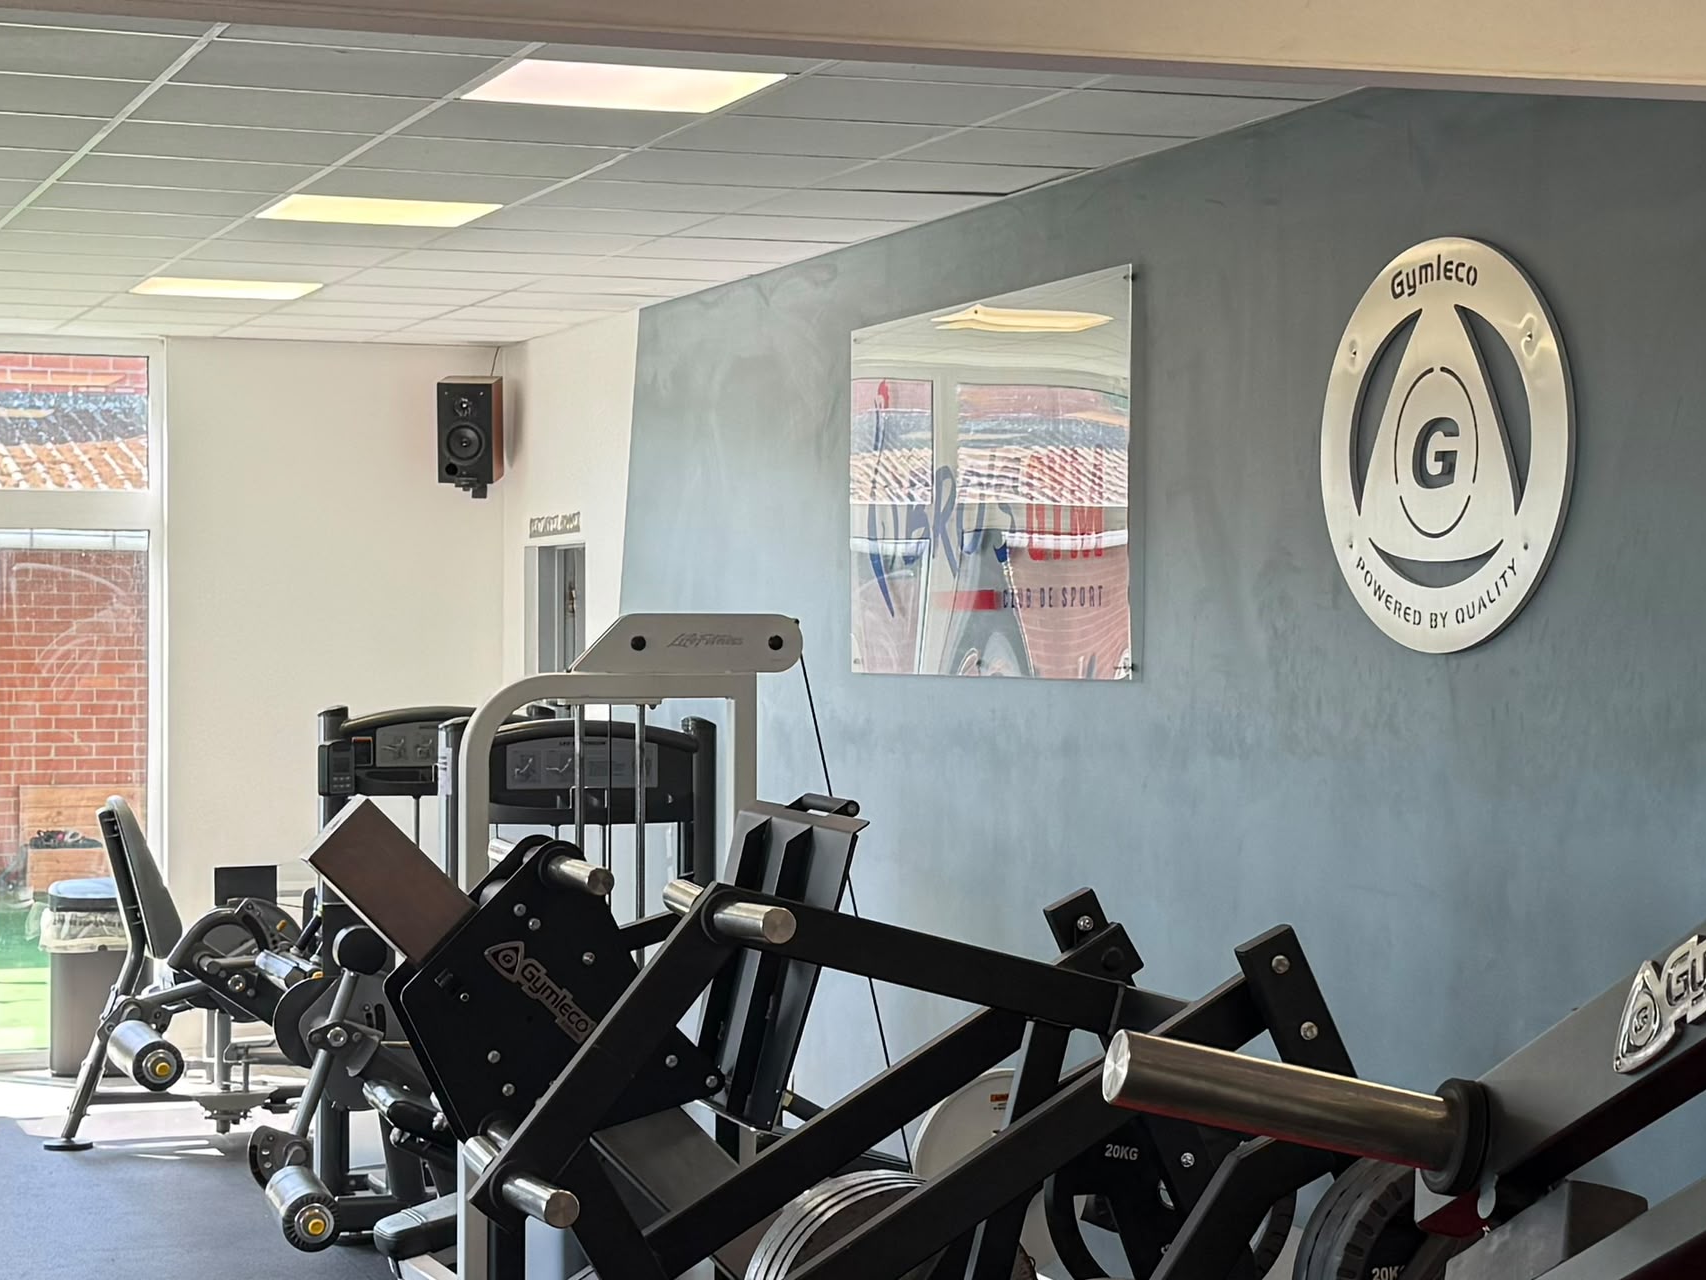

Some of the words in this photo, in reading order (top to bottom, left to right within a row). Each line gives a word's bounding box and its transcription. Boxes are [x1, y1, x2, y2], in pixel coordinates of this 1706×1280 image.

[1390, 254, 1478, 300] Gymleco
[1411, 416, 1460, 489] G
[1002, 587, 1032, 609] CLUB
[1039, 587, 1054, 608] DE
[1061, 585, 1104, 608] SPORT
[1355, 555, 1422, 627] POWERED
[1429, 610, 1448, 629] BY
[1455, 557, 1518, 625] QUALITY
[521, 963, 589, 1032] Gymleco
[1104, 1143, 1139, 1161] 20KG
